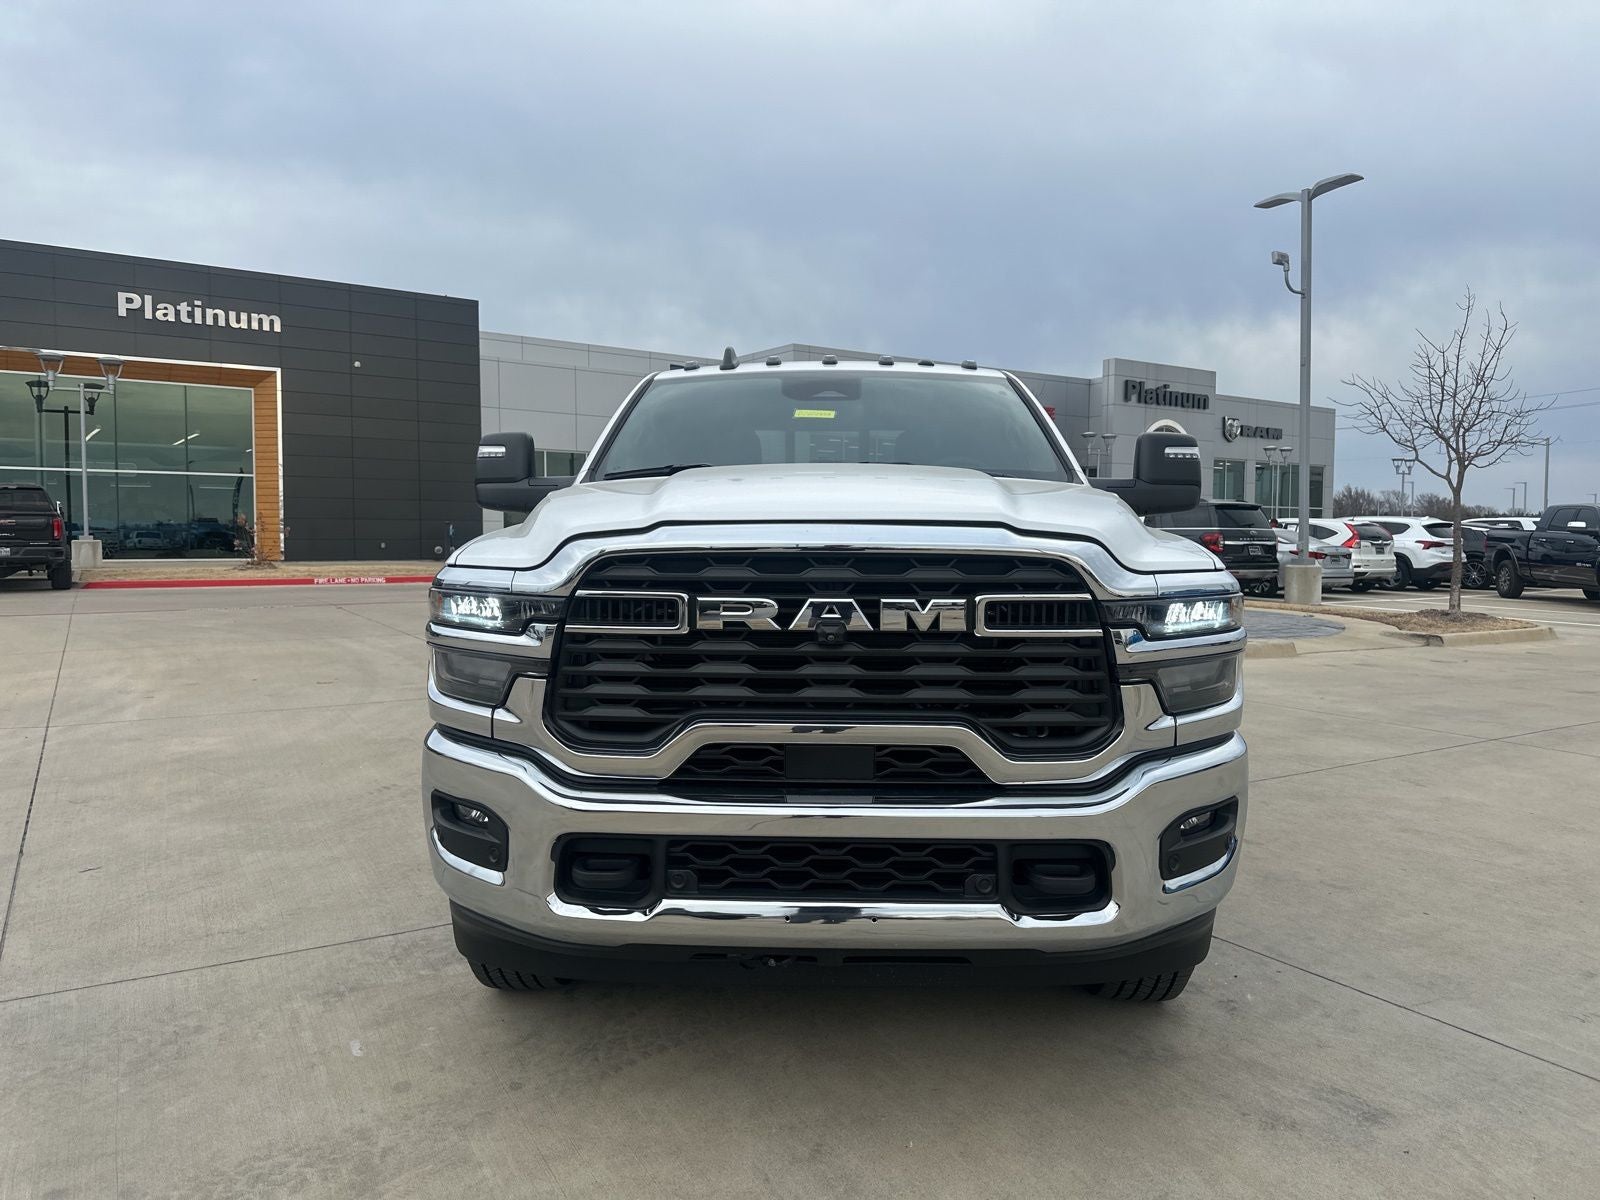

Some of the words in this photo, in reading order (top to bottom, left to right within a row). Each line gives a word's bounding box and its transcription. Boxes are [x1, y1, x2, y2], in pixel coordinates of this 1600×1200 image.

[117, 291, 282, 333] Platinum
[1124, 379, 1210, 410] Platinum
[1240, 424, 1283, 440] RAM
[696, 597, 967, 631] RAM
